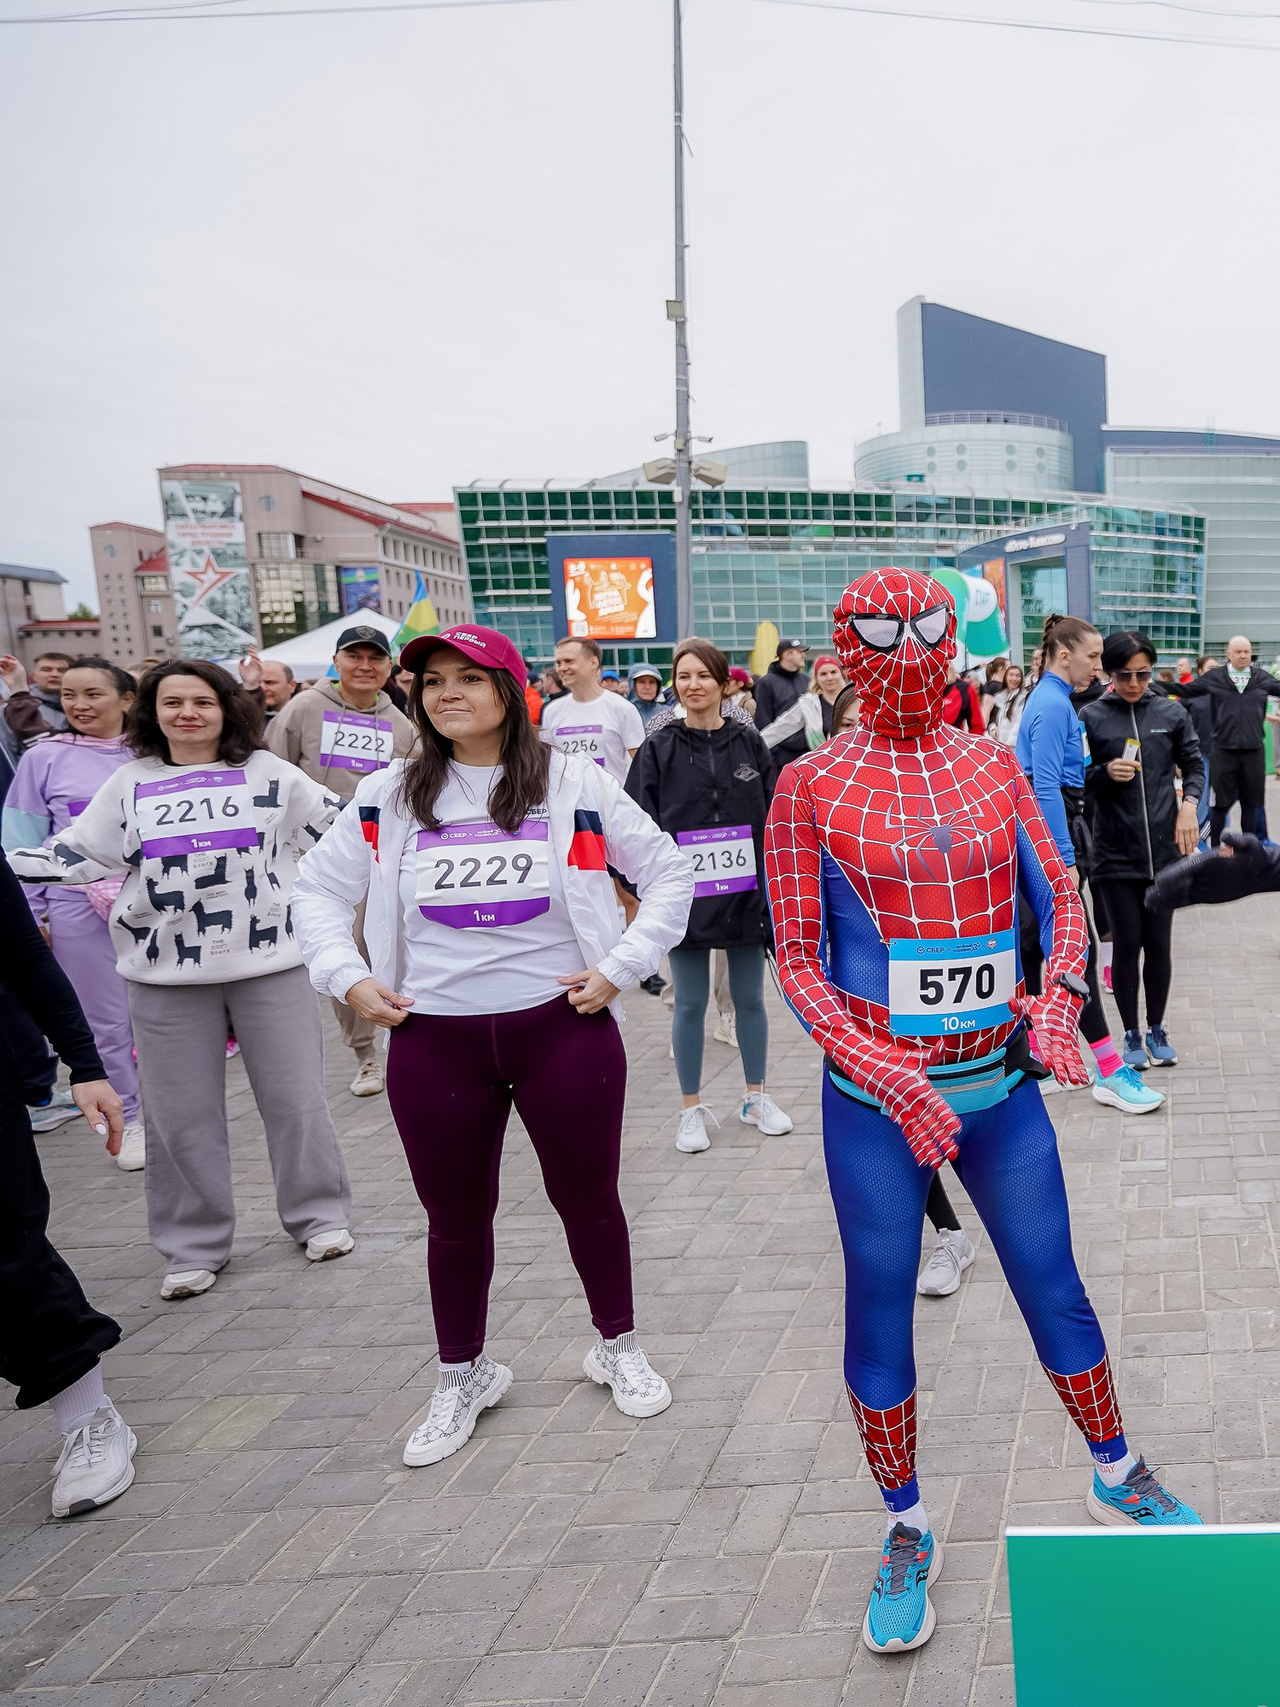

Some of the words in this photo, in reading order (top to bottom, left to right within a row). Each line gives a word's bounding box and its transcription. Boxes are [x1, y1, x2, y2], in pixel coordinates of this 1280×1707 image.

[335, 731, 385, 753] 2222
[563, 739, 598, 754] 2256
[154, 796, 240, 826] 2216
[434, 853, 533, 891] 2229
[692, 848, 747, 872] 2136
[919, 963, 995, 1006] 570
